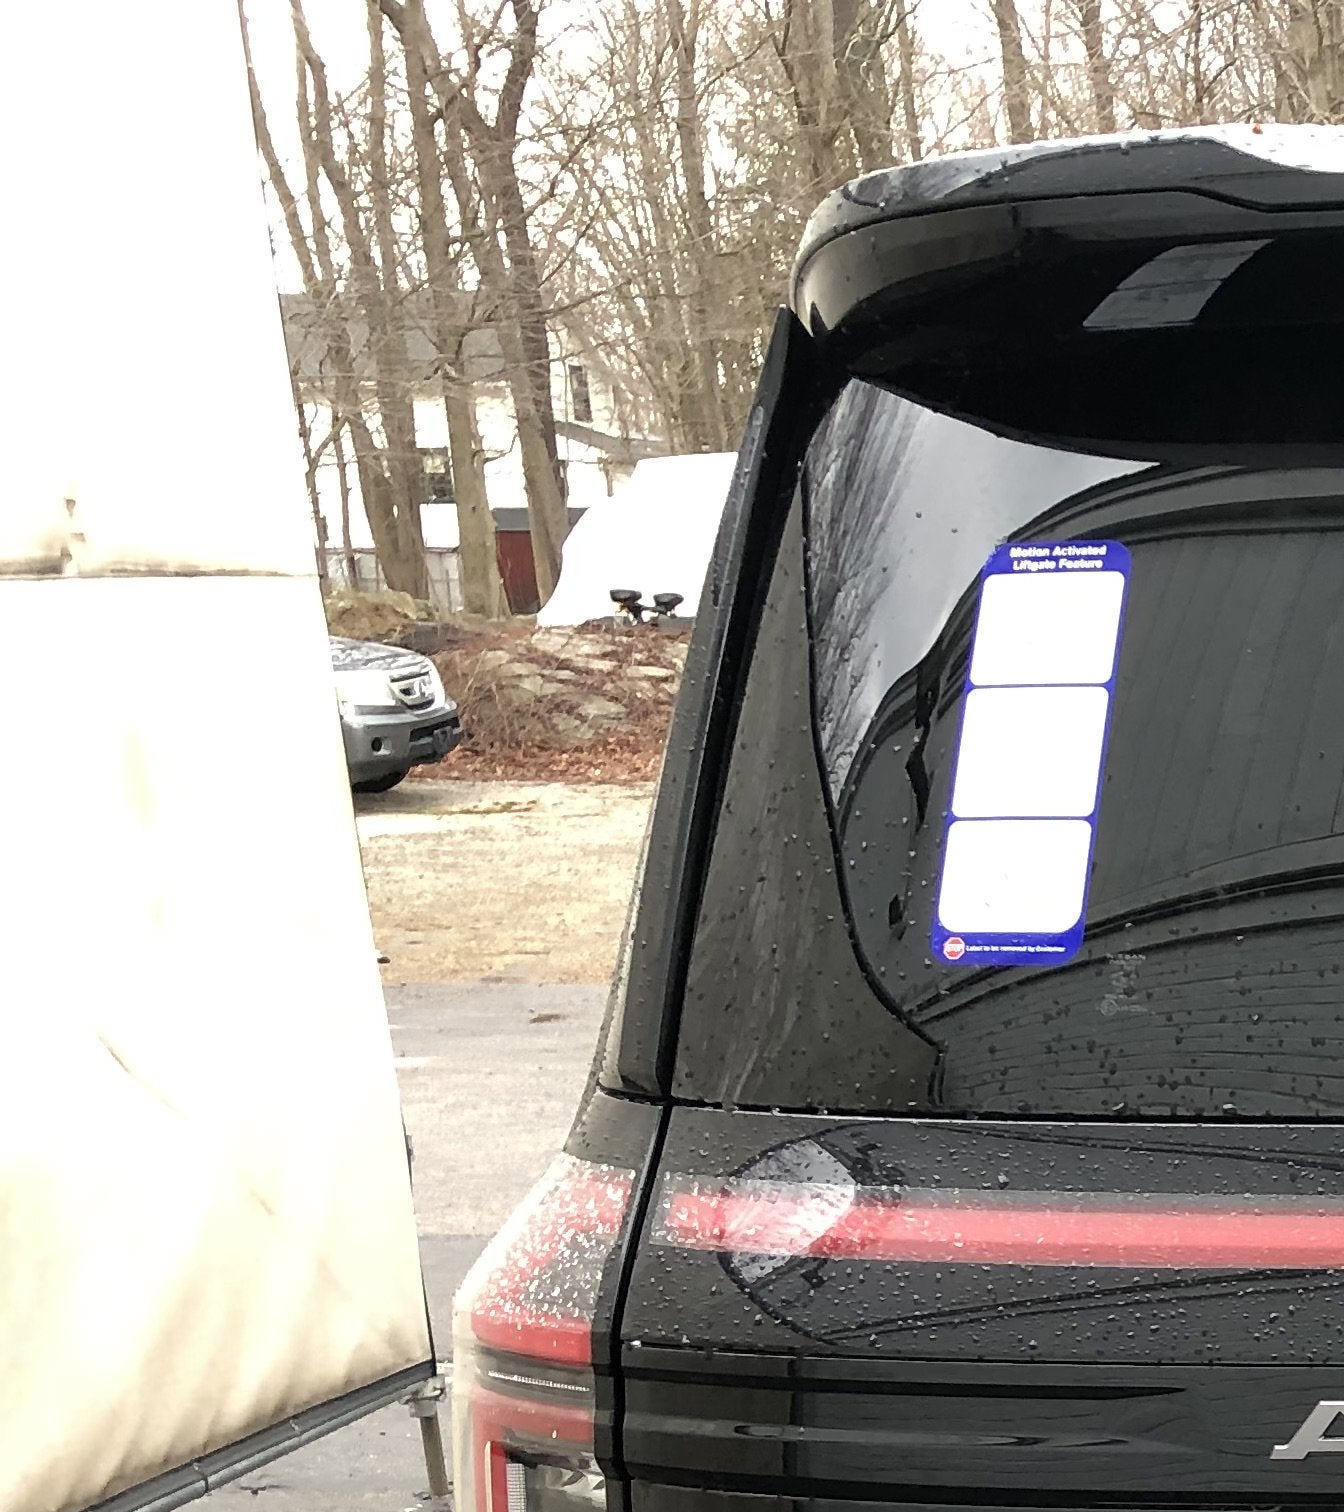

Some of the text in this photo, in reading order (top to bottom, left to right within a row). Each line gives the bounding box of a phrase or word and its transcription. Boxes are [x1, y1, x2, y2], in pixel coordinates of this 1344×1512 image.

[1009, 544, 1107, 558] Motion Activated
[1013, 558, 1103, 571] Liftgate Feature
